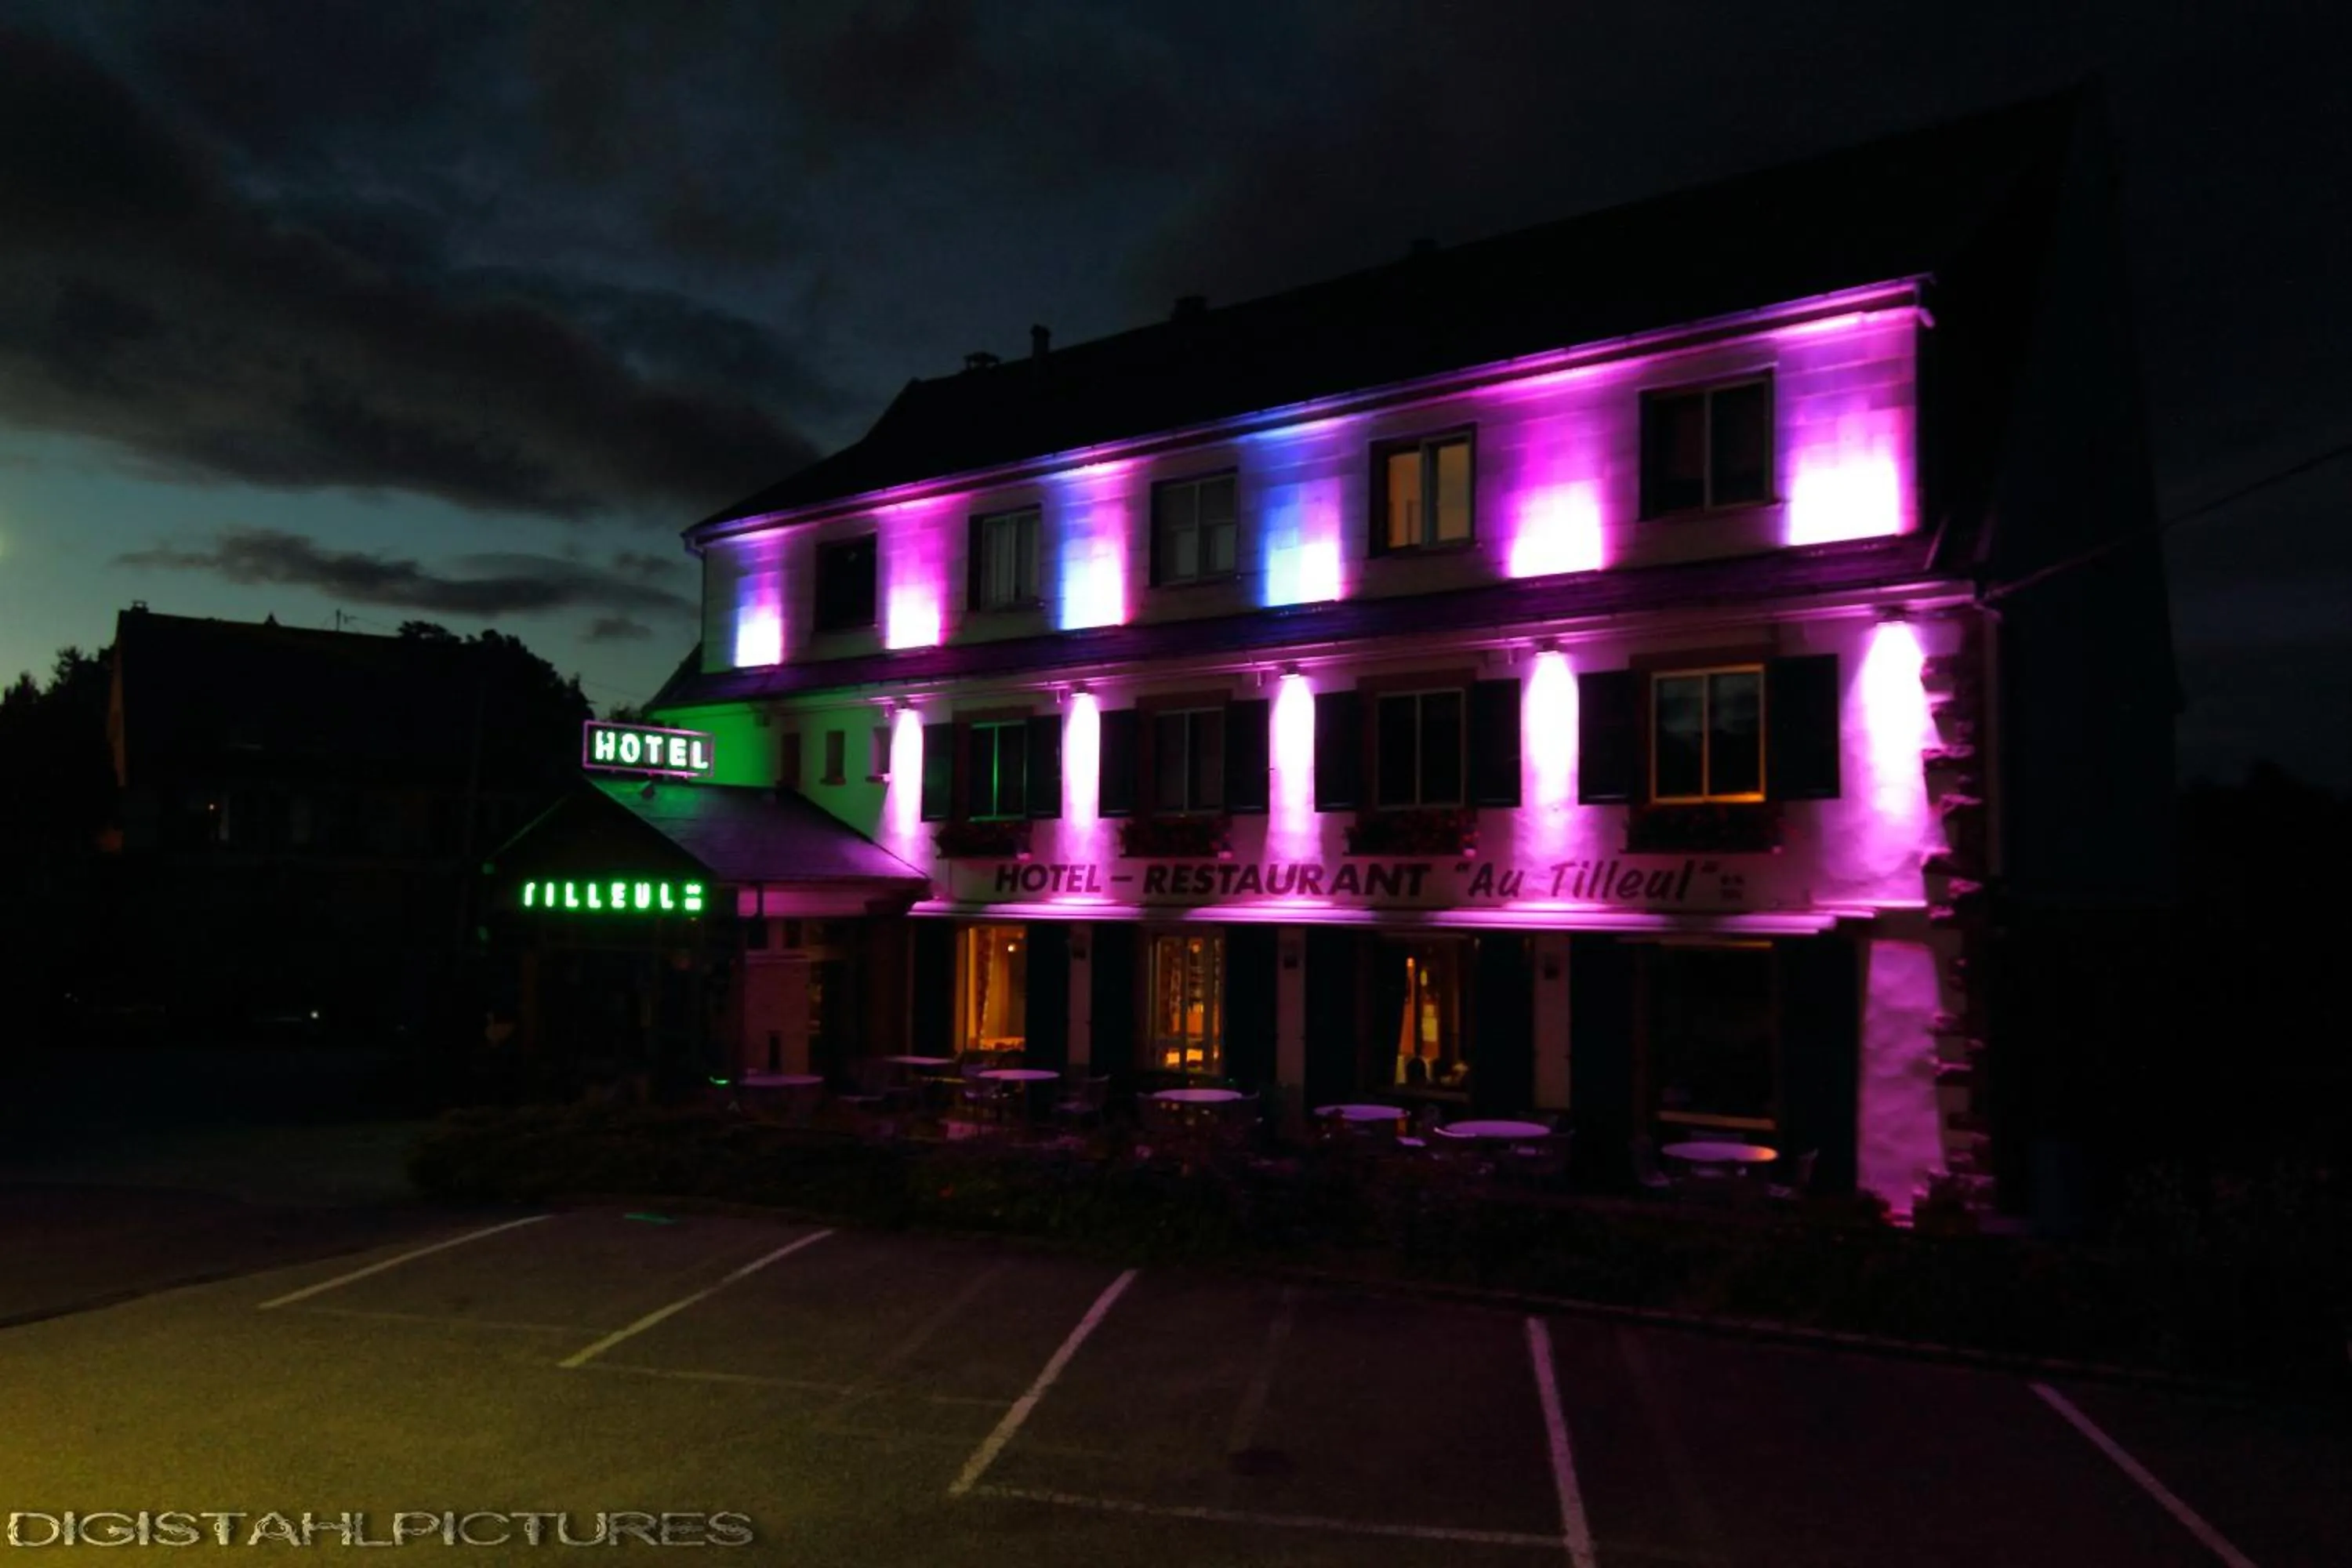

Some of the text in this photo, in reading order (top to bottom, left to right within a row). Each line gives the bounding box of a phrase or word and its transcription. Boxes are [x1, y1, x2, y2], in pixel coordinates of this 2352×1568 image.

[594, 729, 709, 769] HOTEL
[994, 864, 1102, 894] HOTEL
[1143, 862, 1432, 898] RESTAURANT
